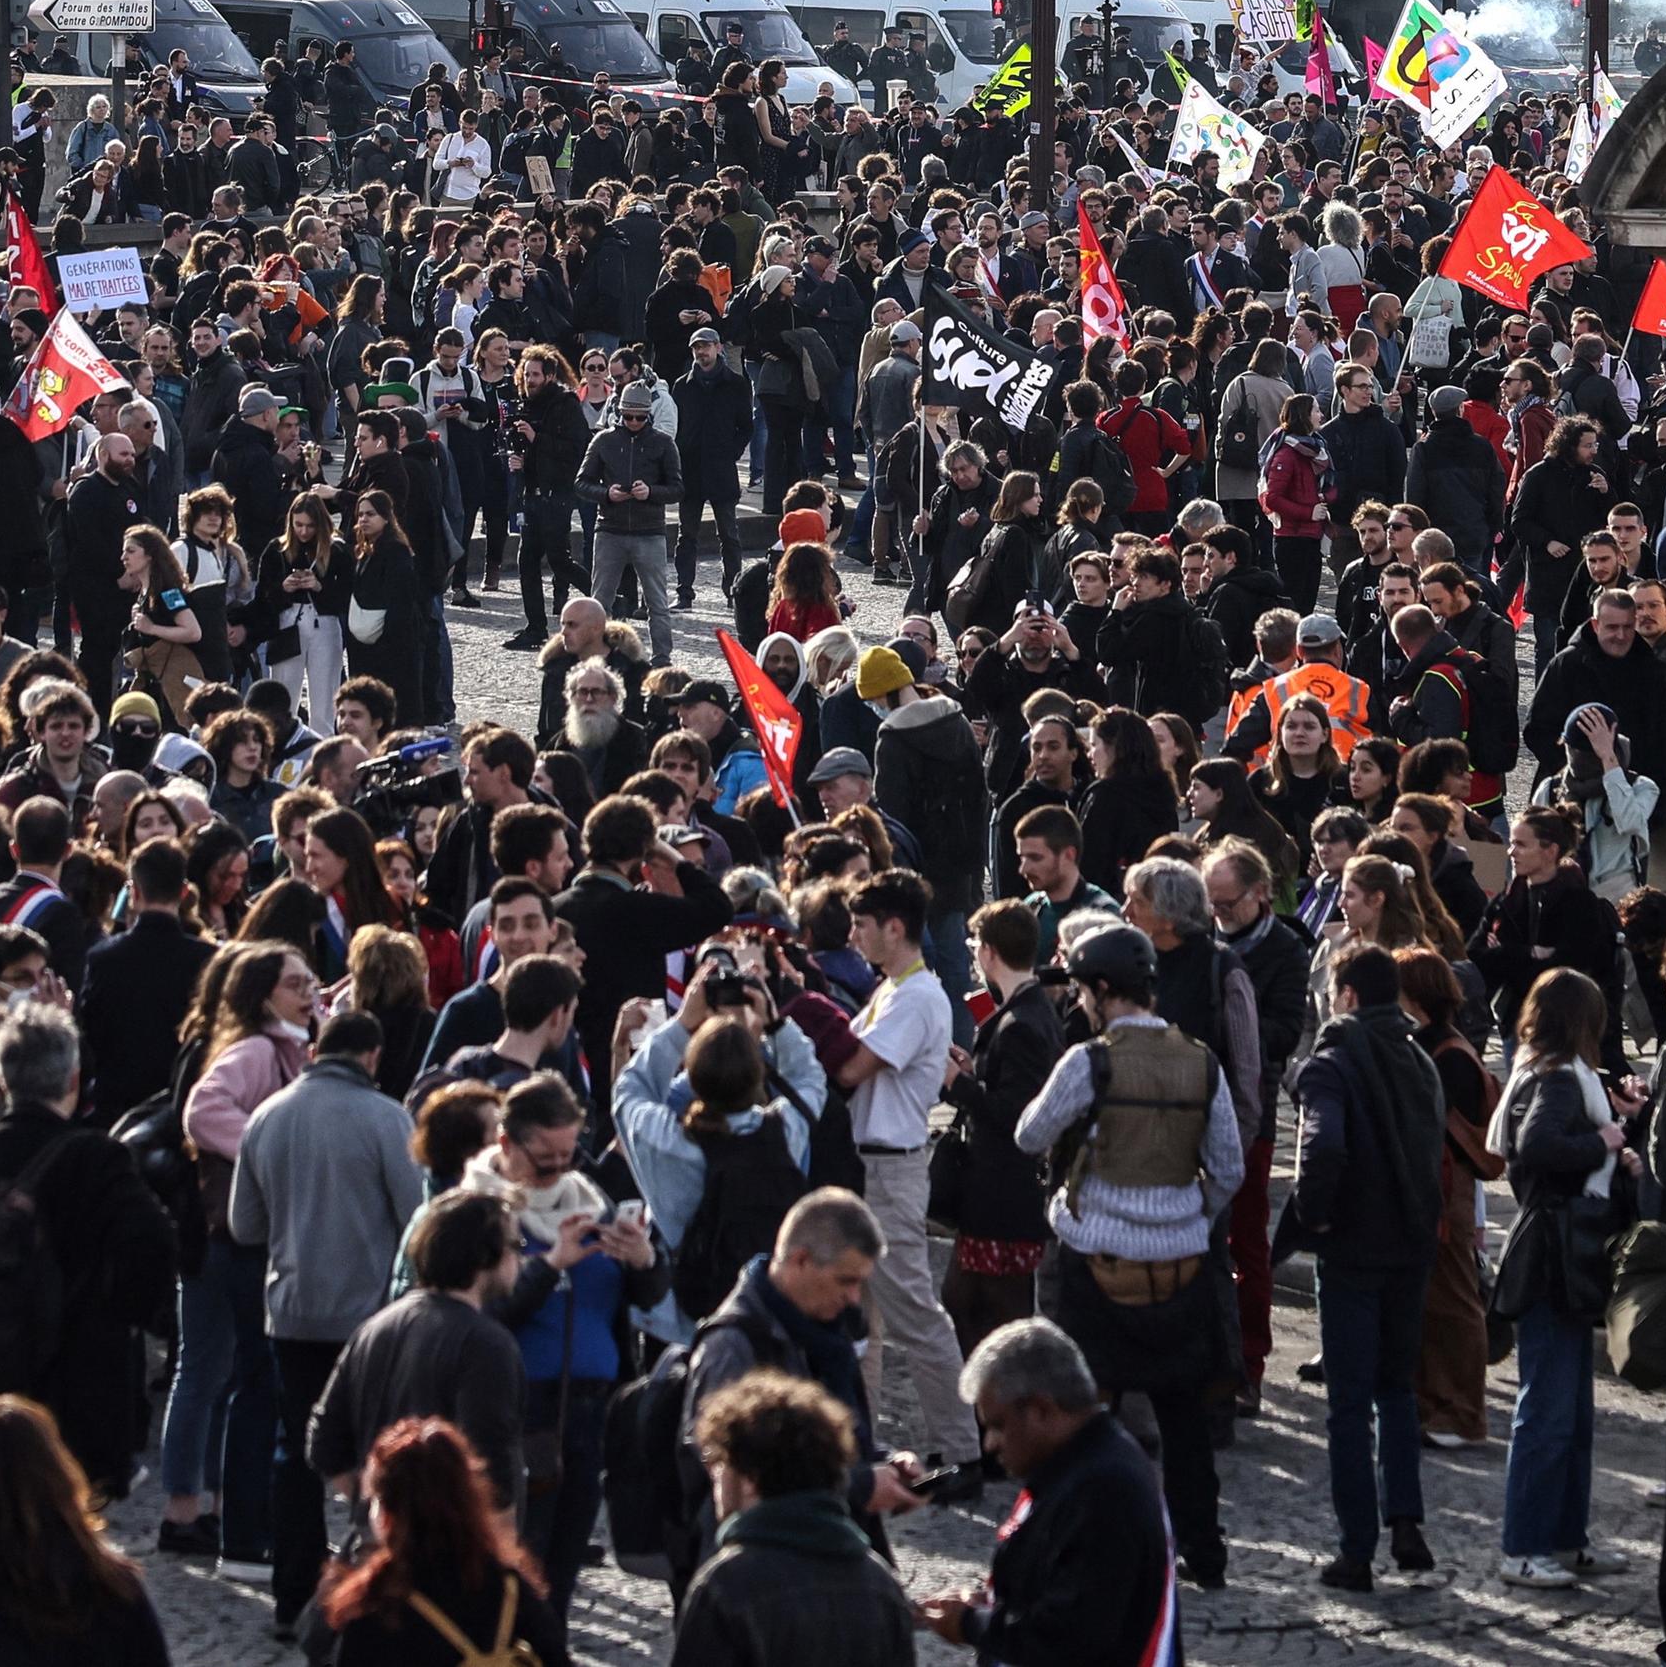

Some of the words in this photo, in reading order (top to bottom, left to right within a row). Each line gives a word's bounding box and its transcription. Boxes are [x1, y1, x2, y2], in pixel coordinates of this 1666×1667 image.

[57, 15, 86, 26] Centre
[62, 2, 91, 12] Forum
[97, 3, 113, 12] des
[119, 3, 148, 13] Halles
[1501, 212, 1551, 262] cgt
[957, 321, 1007, 366] Culture
